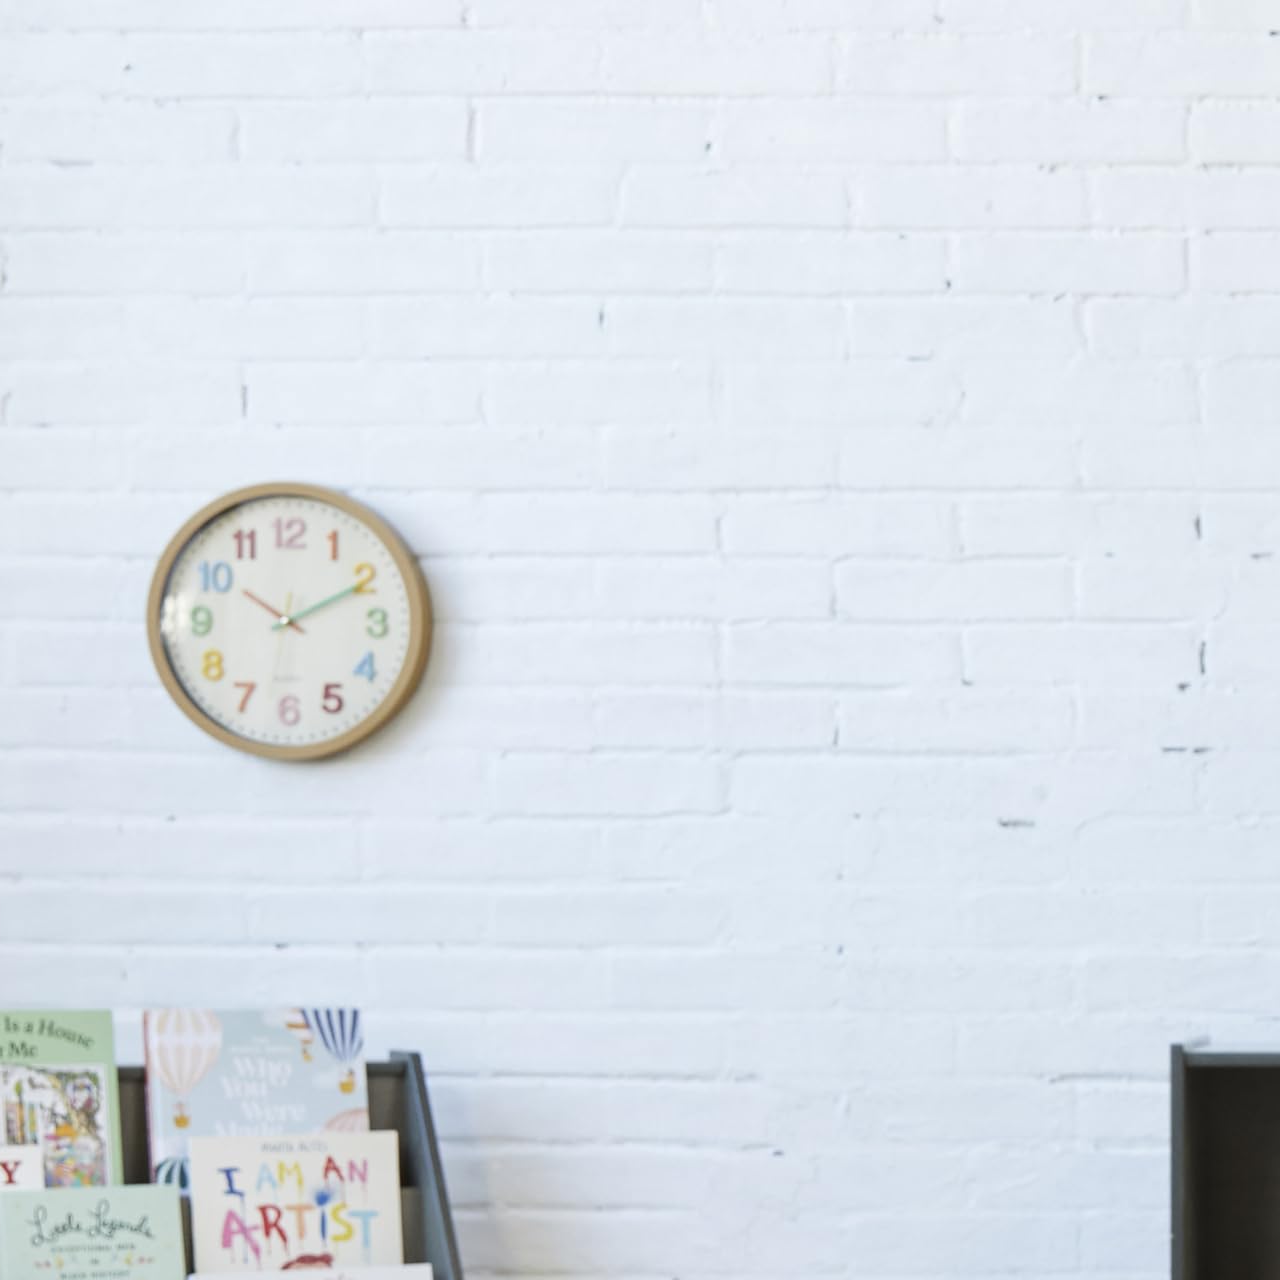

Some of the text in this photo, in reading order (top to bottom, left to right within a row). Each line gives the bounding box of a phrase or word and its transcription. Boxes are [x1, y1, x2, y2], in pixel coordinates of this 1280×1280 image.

[233, 528, 257, 560] 11
[274, 517, 306, 549] 12
[327, 529, 340, 561] 1
[198, 561, 233, 593] 10
[353, 563, 377, 594] 2
[190, 606, 213, 637] 9
[367, 608, 389, 638] 3
[201, 649, 225, 681] 8
[353, 651, 377, 682] 4
[233, 682, 257, 713] 7
[278, 695, 301, 726] 6
[322, 684, 344, 714] 5
[8, 1040, 38, 1058] Me
[38, 1018, 95, 1050] House
[218, 1155, 369, 1197] I AM AN
